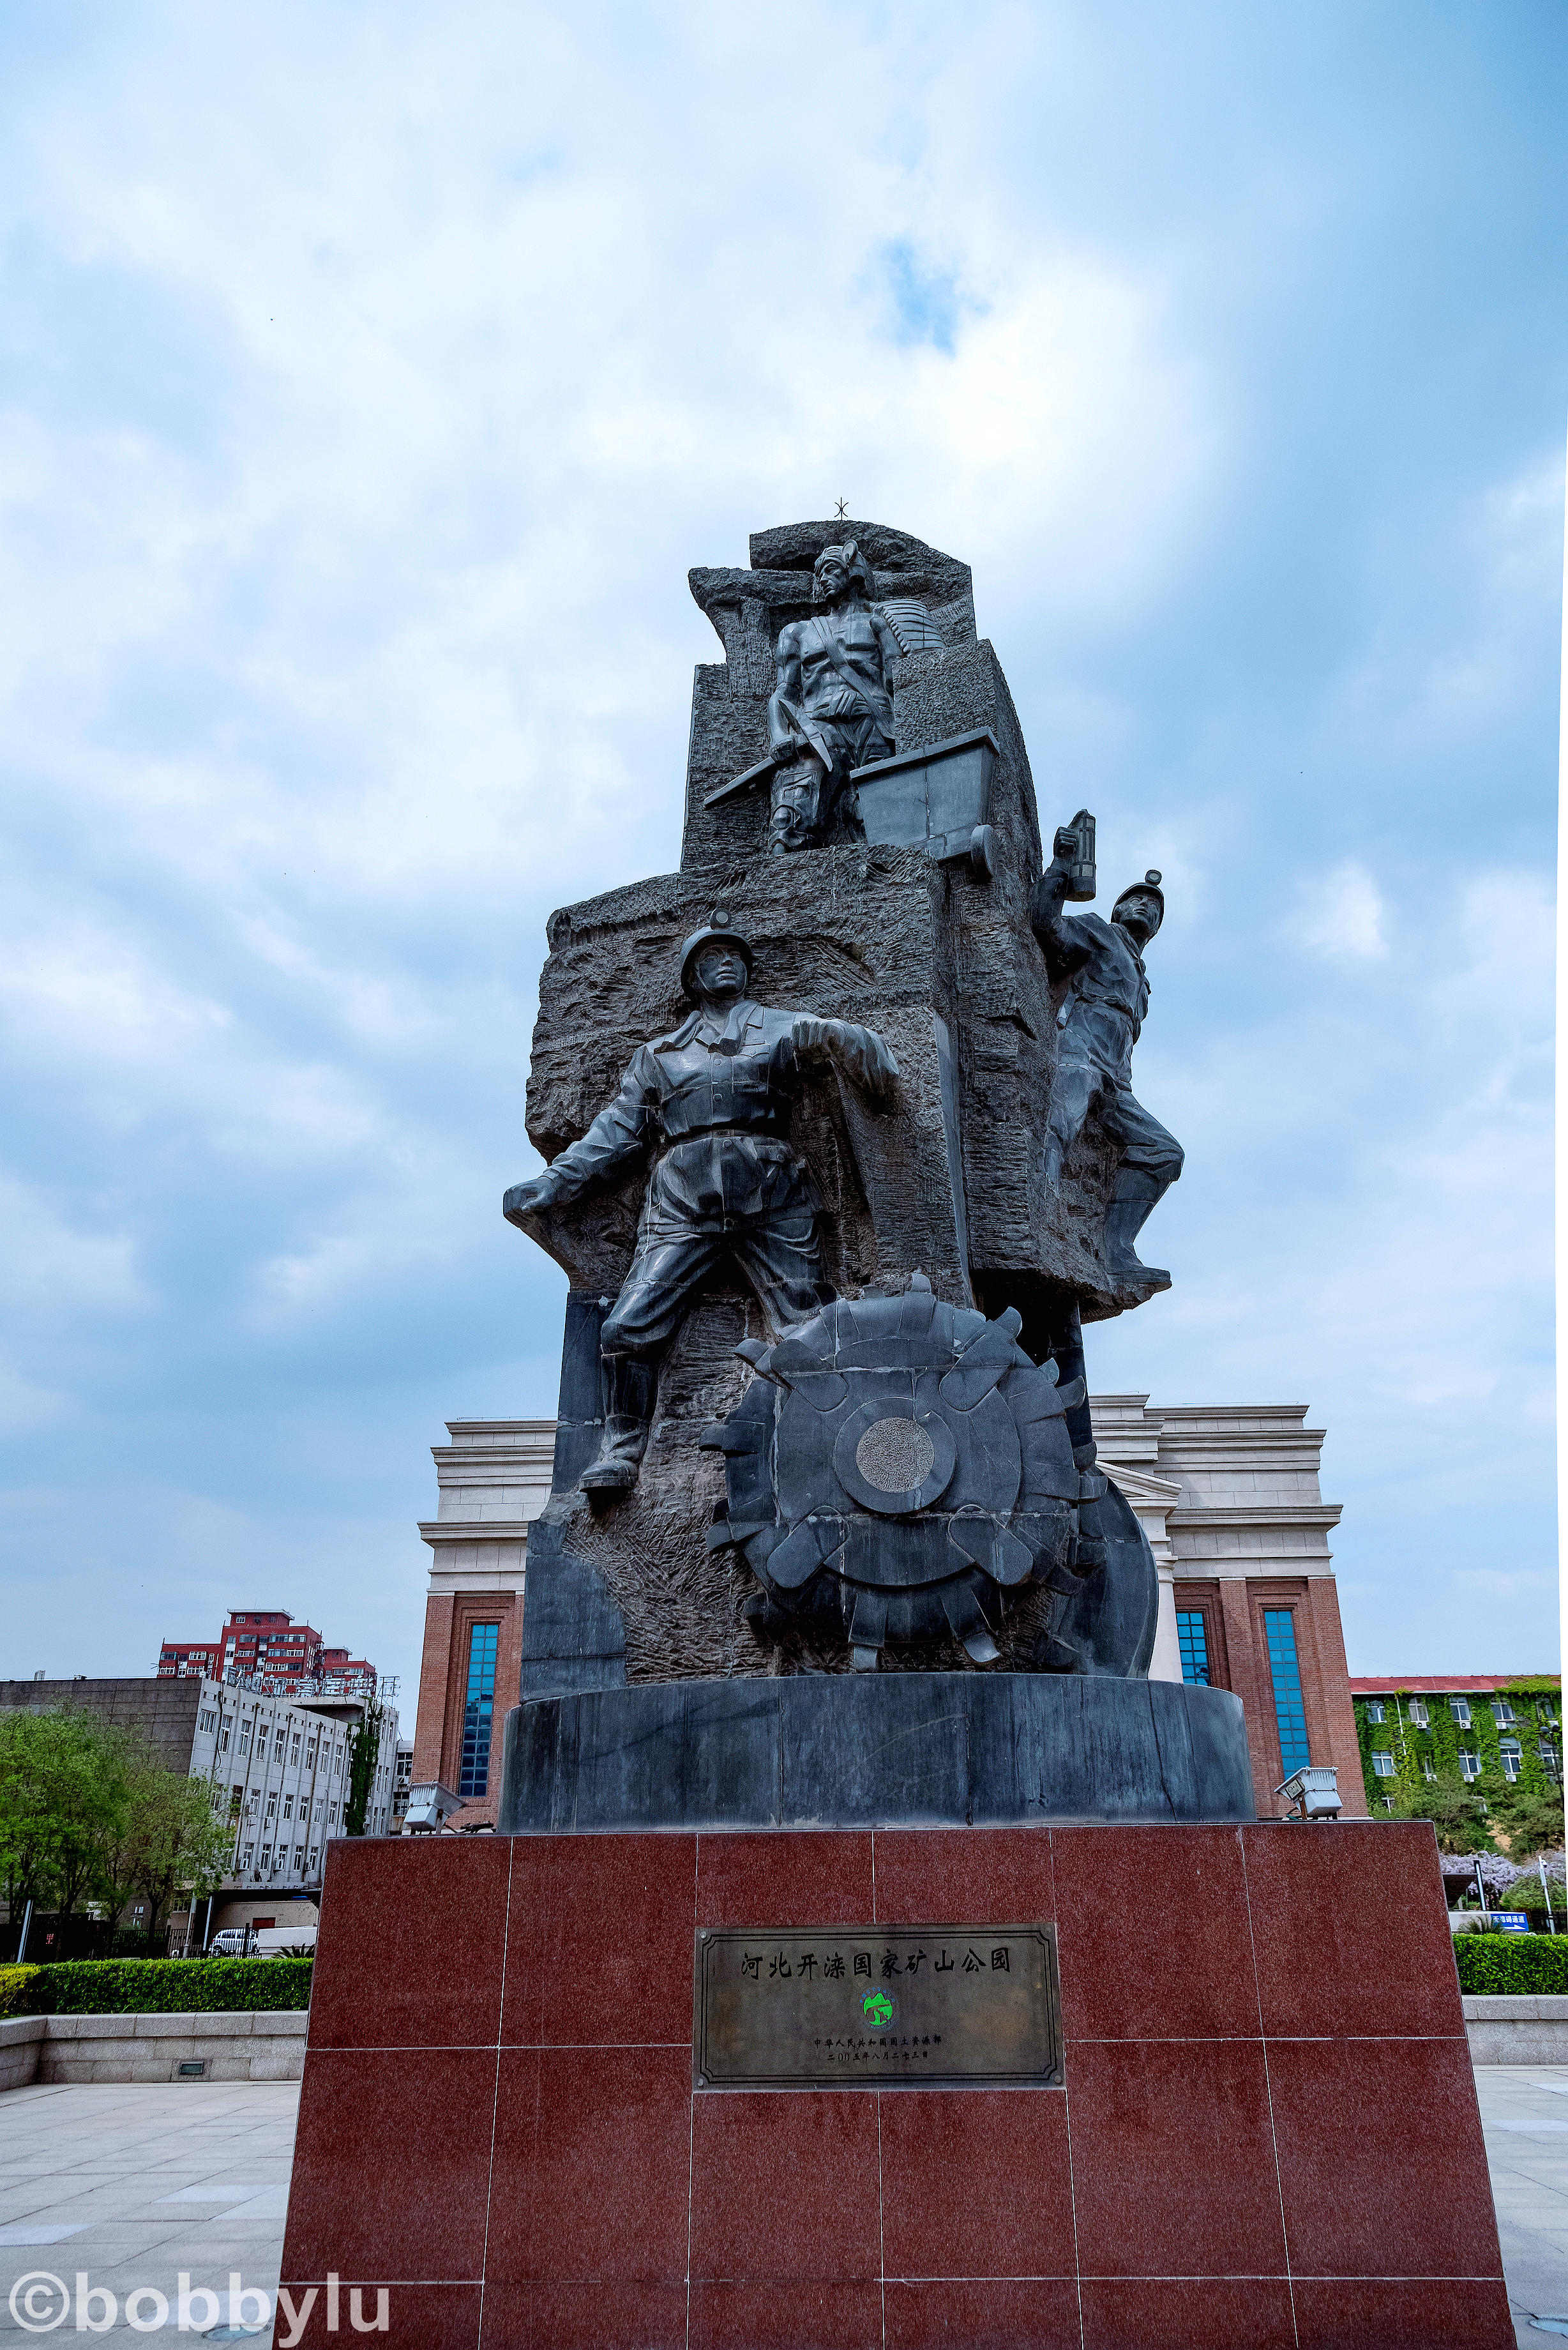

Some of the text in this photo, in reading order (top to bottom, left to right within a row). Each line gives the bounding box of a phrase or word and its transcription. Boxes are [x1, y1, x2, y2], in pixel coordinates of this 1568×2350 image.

[741, 1947, 1011, 1980] 河北开滦国家矿山公园
[814, 2035, 942, 2049] 中华人民共和国国土资源部
